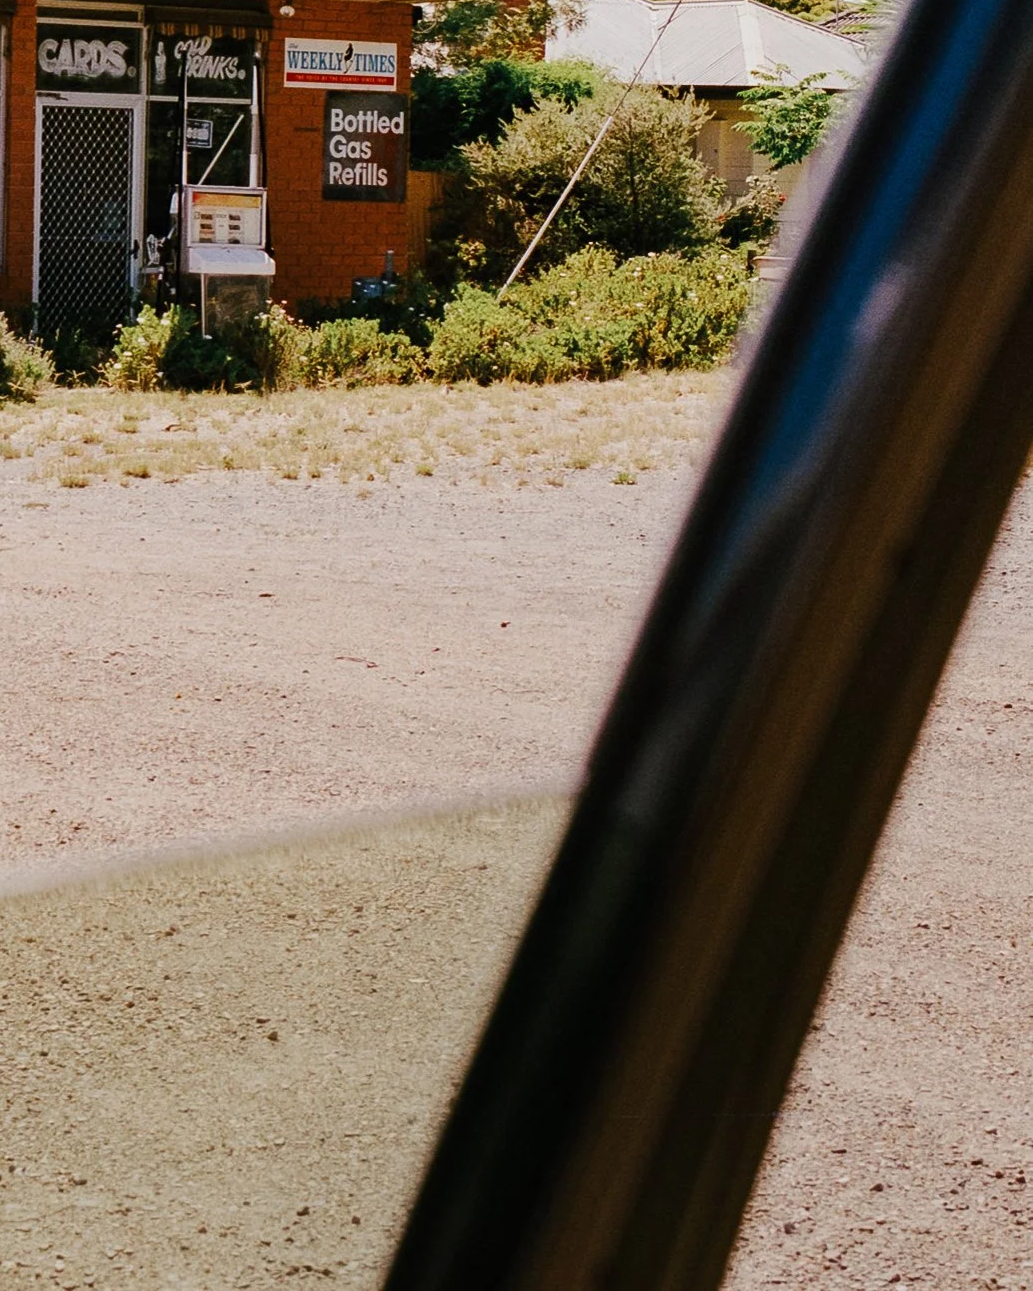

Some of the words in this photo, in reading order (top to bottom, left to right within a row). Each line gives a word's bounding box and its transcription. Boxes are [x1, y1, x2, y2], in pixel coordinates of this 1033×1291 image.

[287, 50, 344, 71] WEEKLY
[354, 53, 396, 74] TIMES
[330, 108, 405, 135] Bottled
[329, 134, 372, 159] Gas
[329, 161, 388, 186] Refills
